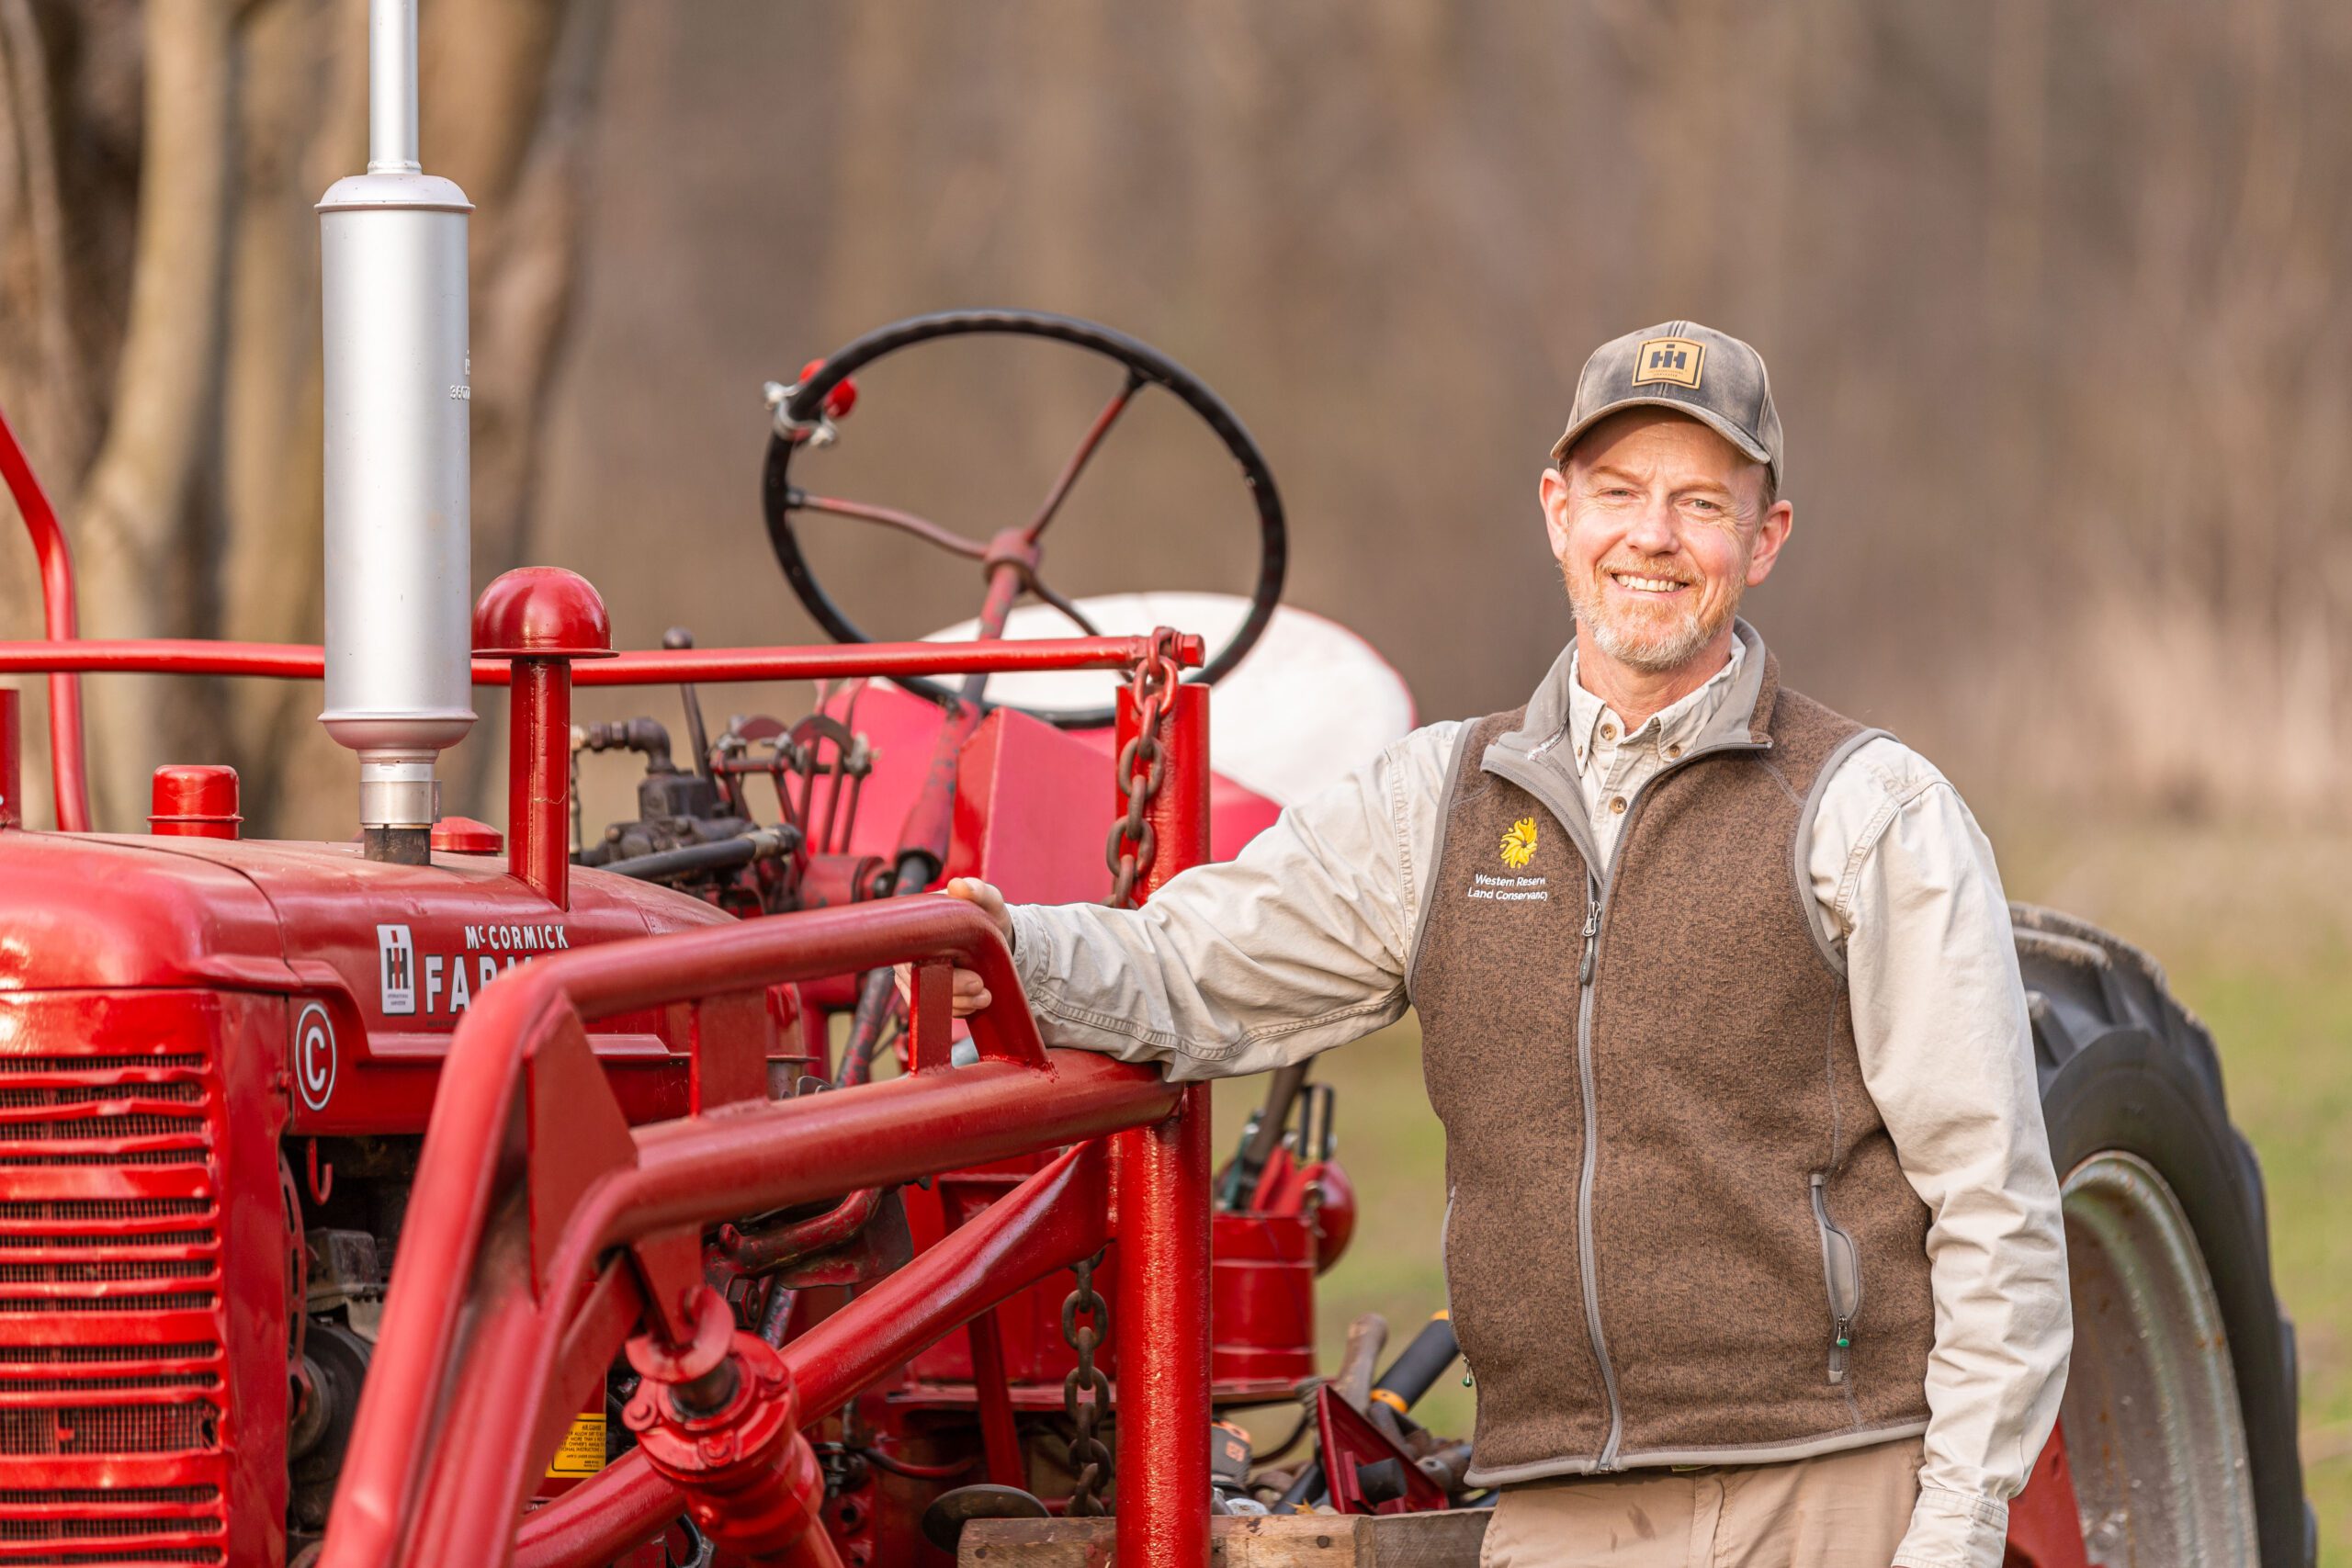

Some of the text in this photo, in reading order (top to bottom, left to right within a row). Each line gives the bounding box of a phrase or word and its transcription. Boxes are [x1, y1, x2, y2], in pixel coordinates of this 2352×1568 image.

[1476, 874, 1515, 886] Western
[1467, 886, 1548, 901] Land Conservancy
[424, 954, 535, 1014] FAR
